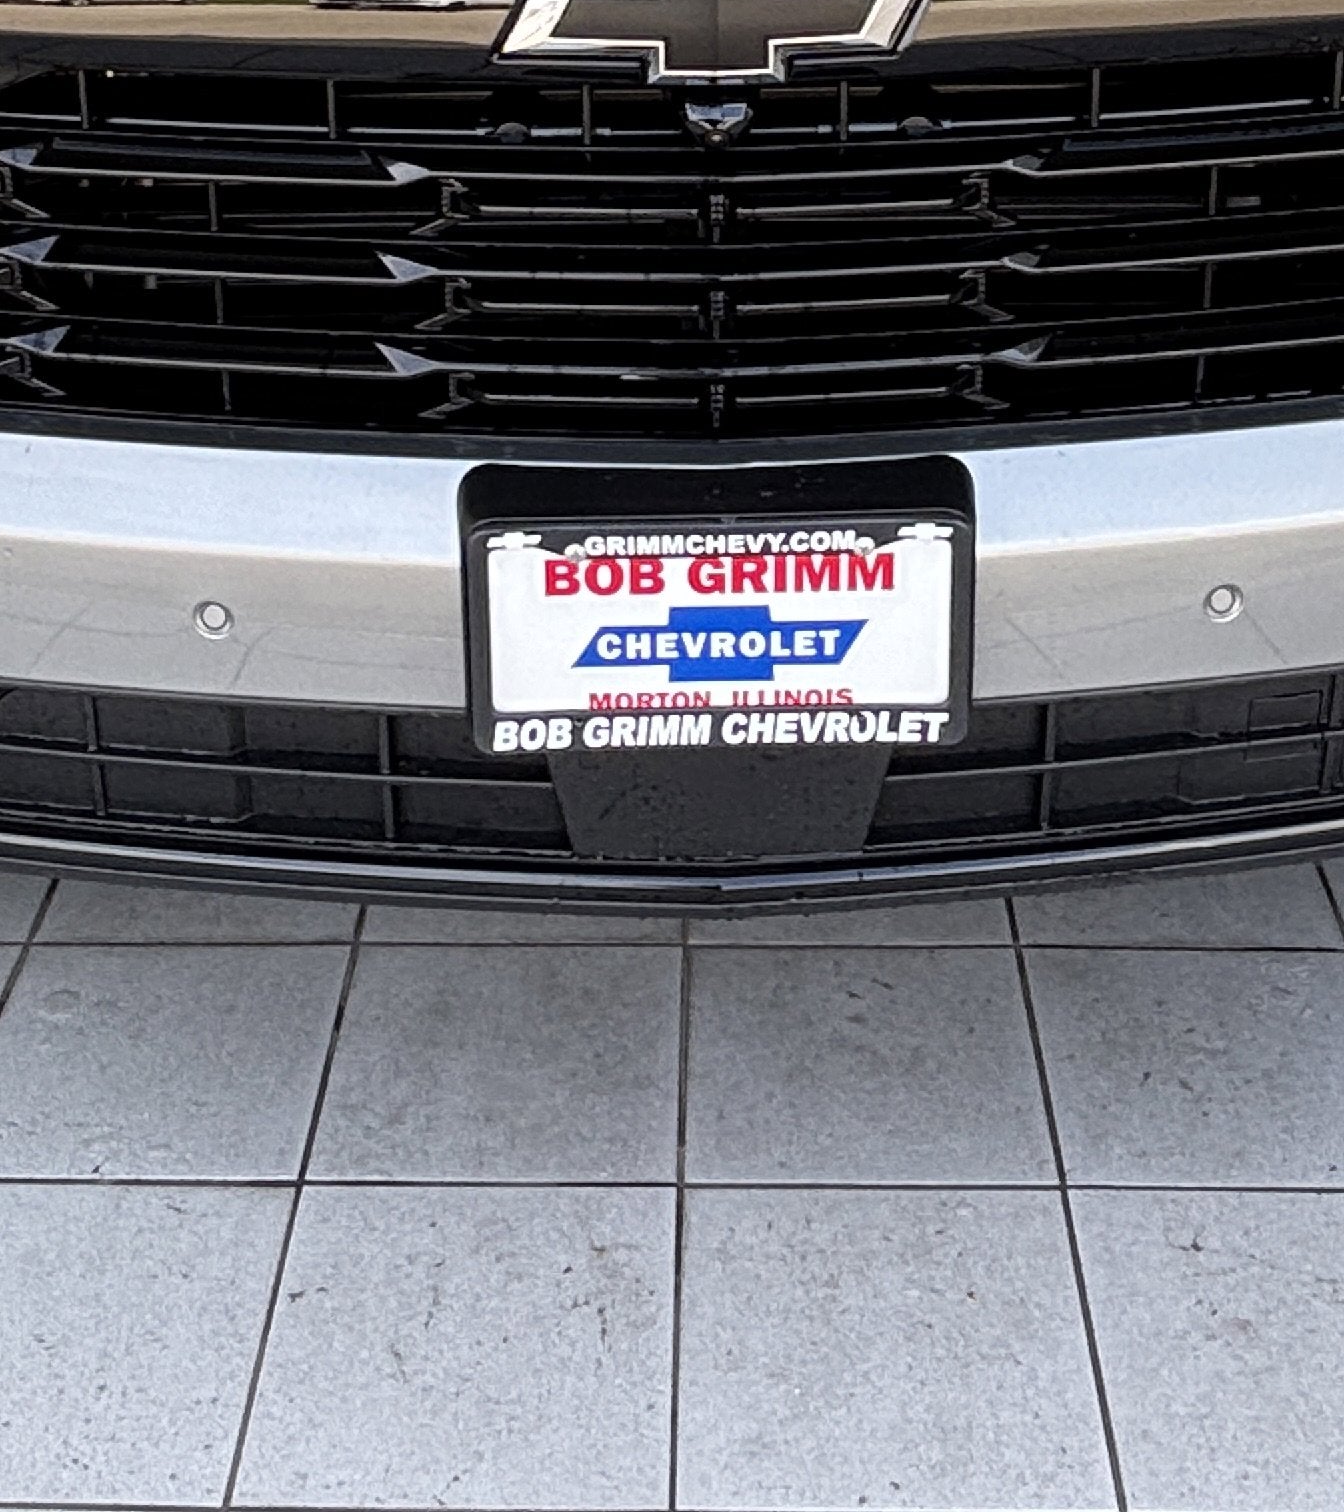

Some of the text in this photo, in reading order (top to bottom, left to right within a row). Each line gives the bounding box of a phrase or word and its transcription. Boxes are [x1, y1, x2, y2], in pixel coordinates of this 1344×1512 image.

[584, 530, 857, 557] GRIMMCHEVY.COM
[545, 552, 895, 597] BOB GRIMM
[596, 628, 842, 660] CHEVROLET
[588, 690, 712, 712] MORTON
[492, 710, 951, 753] BOB GRIMM CHEVROLET
